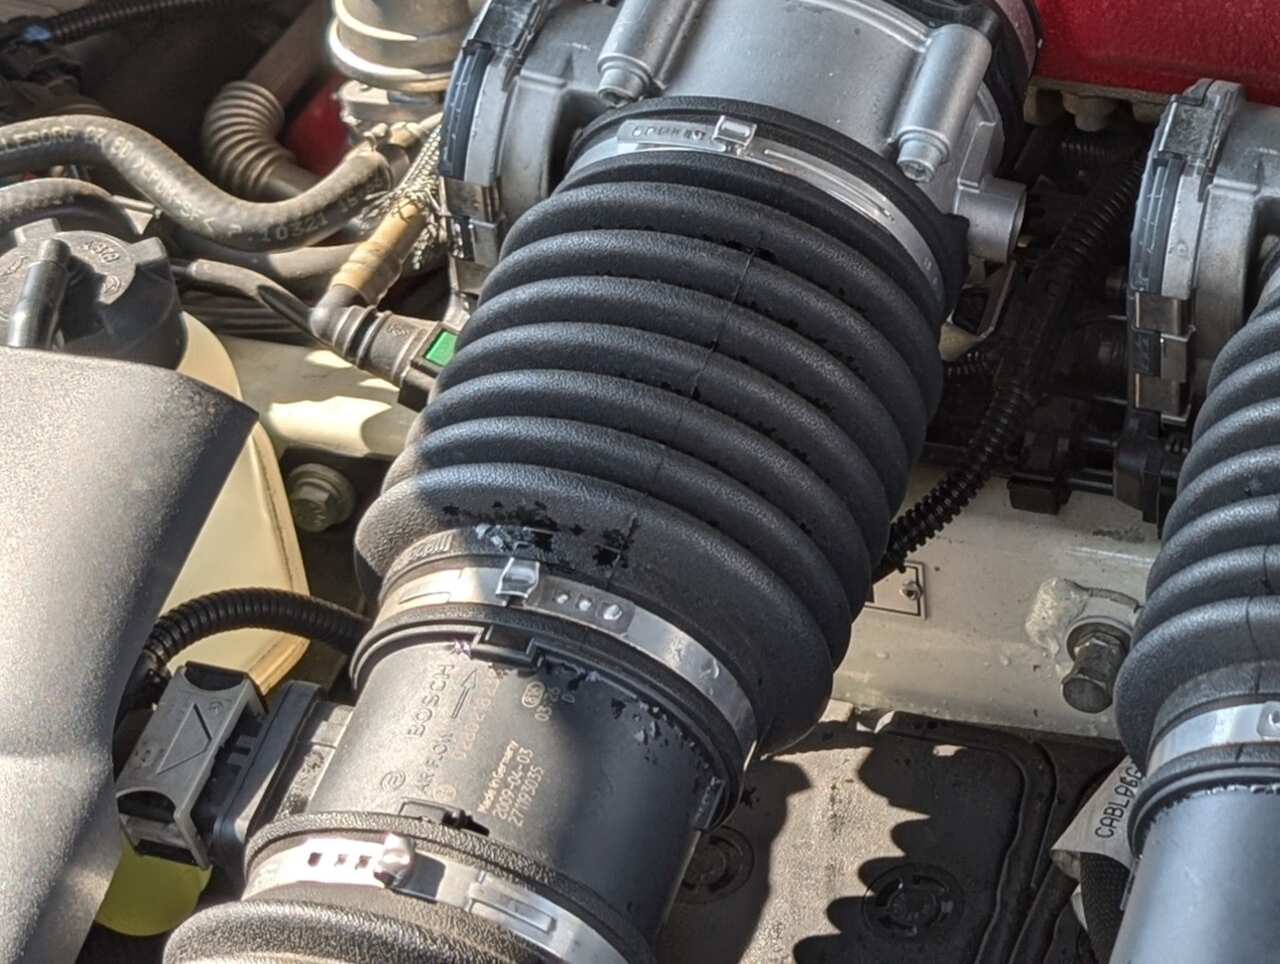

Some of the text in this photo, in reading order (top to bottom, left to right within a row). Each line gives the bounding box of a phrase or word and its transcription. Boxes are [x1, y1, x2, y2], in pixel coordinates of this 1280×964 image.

[407, 663, 456, 738] BOSCH
[491, 745, 535, 820] 2009-04-03
[492, 738, 519, 780] Germany
[507, 764, 546, 828] 271193035
[1094, 762, 1148, 840] CABLAGG
